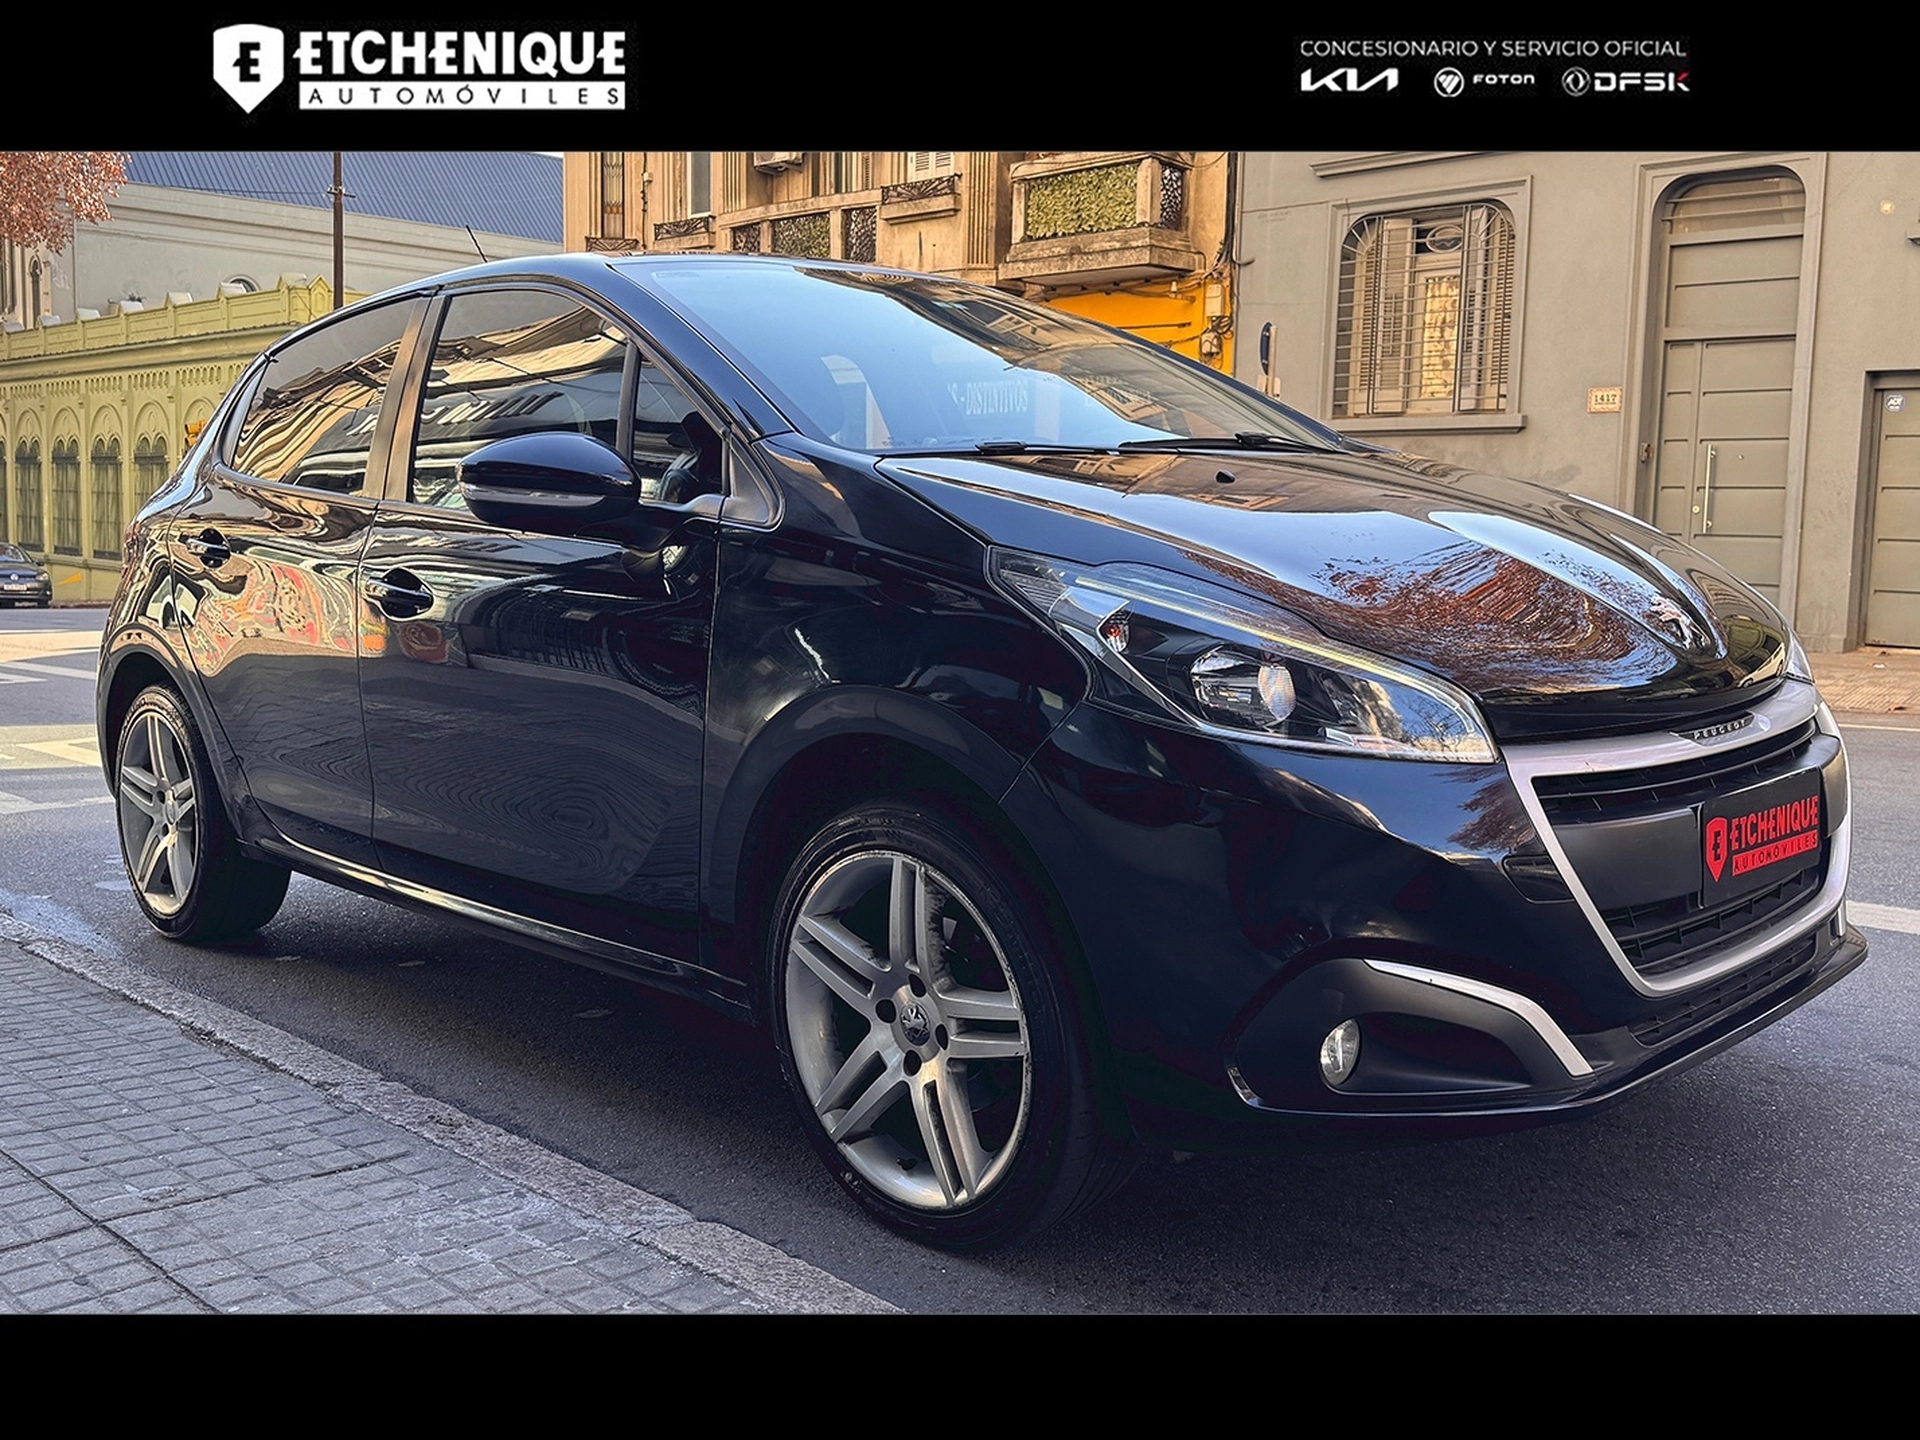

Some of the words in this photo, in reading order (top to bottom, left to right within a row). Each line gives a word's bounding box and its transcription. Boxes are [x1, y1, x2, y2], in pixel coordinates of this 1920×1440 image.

[1594, 393, 1617, 402] 1417
[1693, 719, 1746, 740] PEUGEOT
[1730, 795, 1819, 851] ETCHENIQUE
